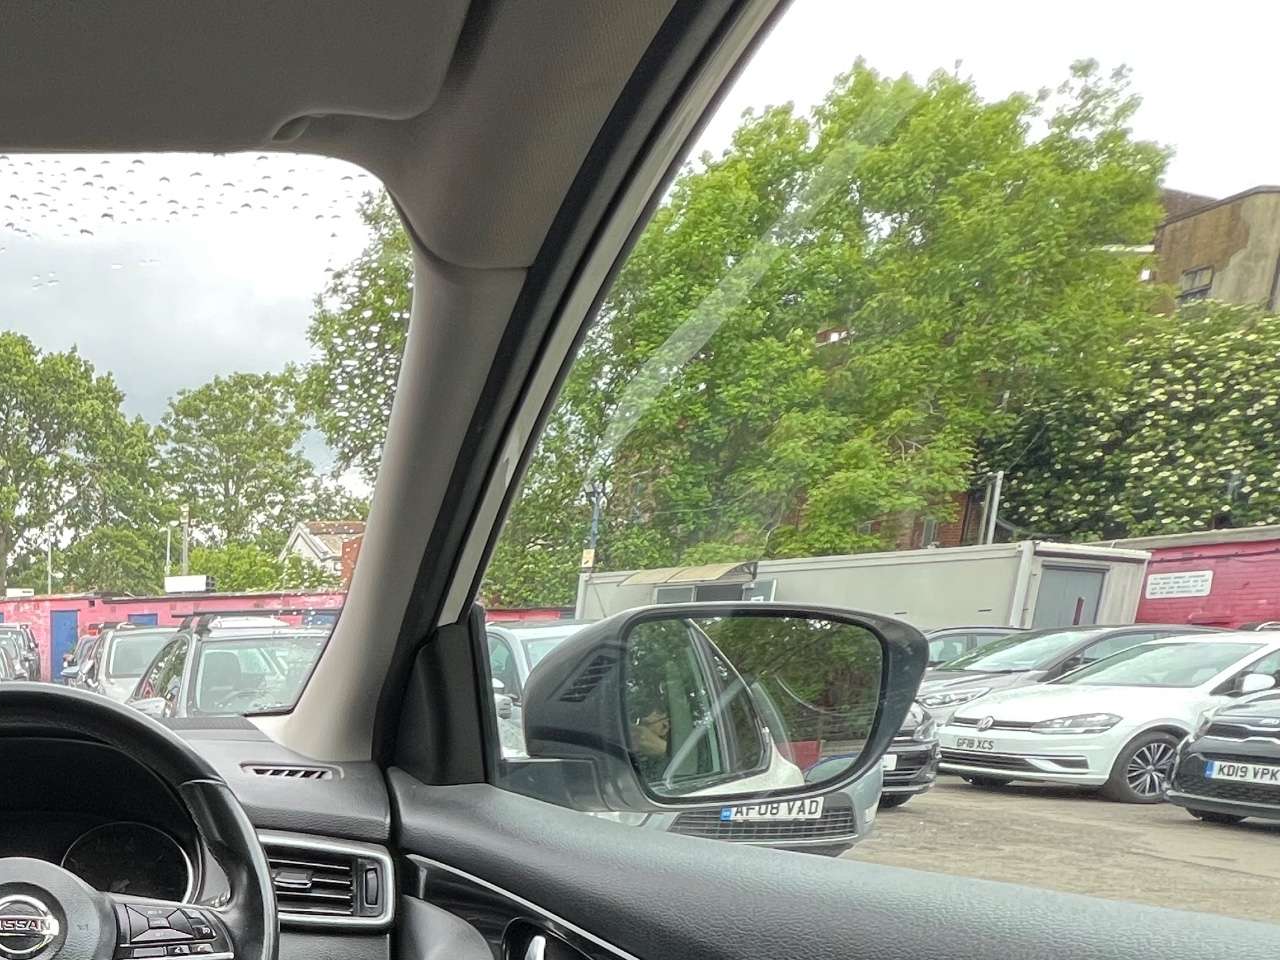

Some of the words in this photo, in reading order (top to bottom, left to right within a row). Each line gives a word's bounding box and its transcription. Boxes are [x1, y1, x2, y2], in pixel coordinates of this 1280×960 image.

[1218, 764, 1248, 778] KD19
[1253, 767, 1280, 781] VPK
[787, 800, 819, 815] VAD
